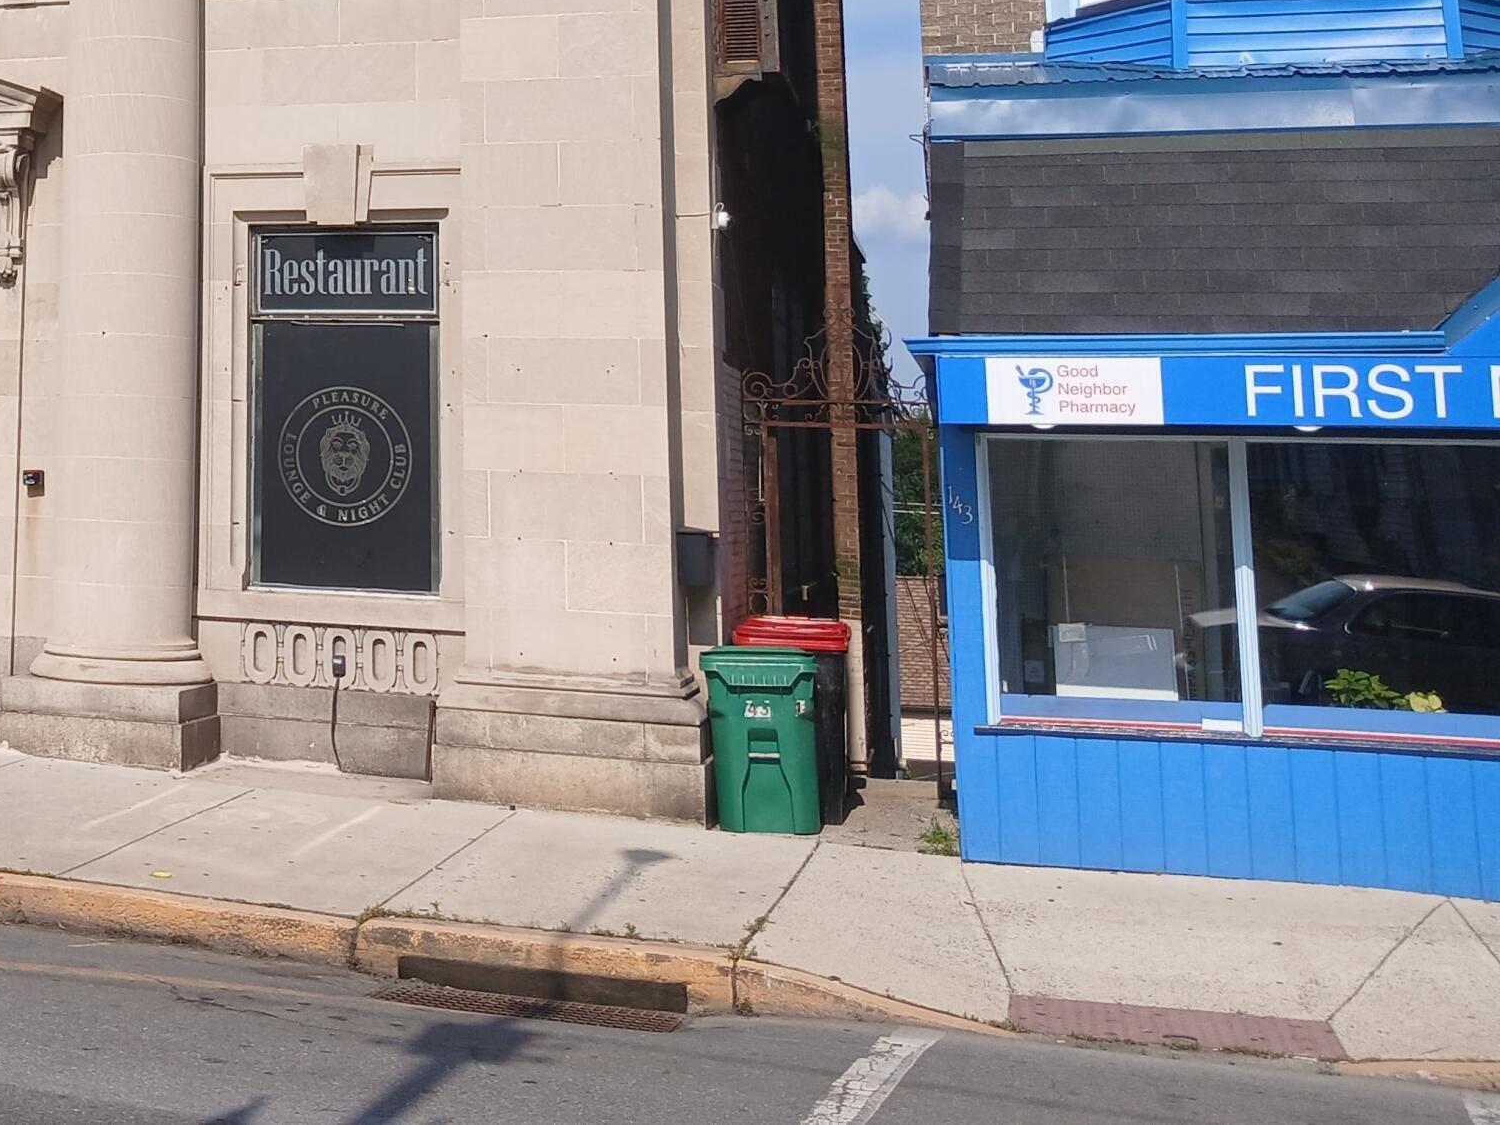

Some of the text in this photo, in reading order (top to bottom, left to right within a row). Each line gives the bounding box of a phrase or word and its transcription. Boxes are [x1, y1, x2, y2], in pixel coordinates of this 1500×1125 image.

[263, 247, 428, 295] Restaurant
[1056, 364, 1099, 377] Good
[311, 391, 389, 420] PLEASURE
[1057, 382, 1128, 398] Neighbor
[1244, 364, 1463, 419] FIRST
[1059, 400, 1136, 416] Pharmacy
[283, 433, 312, 504] LOUNGE
[338, 493, 390, 521] NIGHT
[389, 443, 407, 490] CLUB
[947, 486, 974, 525] 143
